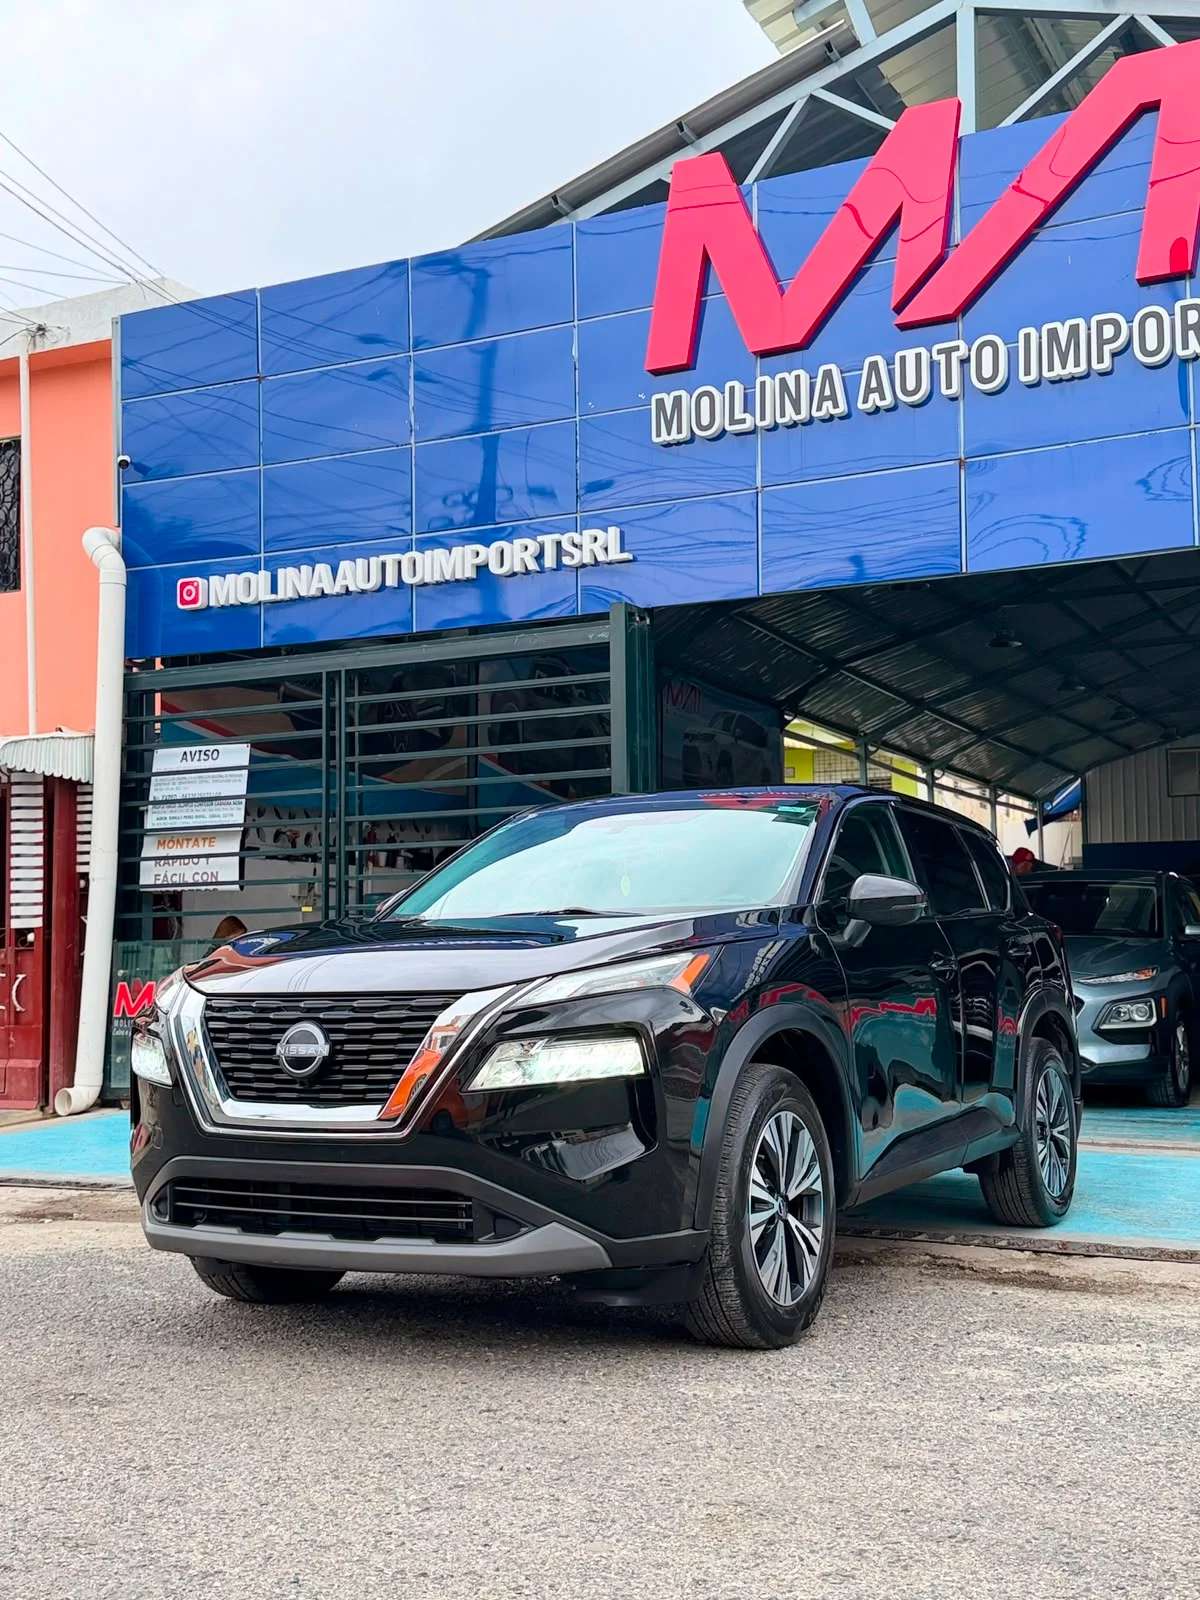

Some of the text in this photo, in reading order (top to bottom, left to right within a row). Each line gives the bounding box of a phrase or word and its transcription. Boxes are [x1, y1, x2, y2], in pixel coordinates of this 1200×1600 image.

[650, 364, 849, 446] MOLINA
[857, 334, 1010, 412] AUTO
[208, 526, 634, 608] MOLINAAUTOIMPORTSRL
[180, 748, 220, 763] AVISO
[156, 836, 217, 850] MÓNTATE
[153, 870, 219, 884] FÁCIL CON
[277, 1044, 328, 1056] NISSAN
